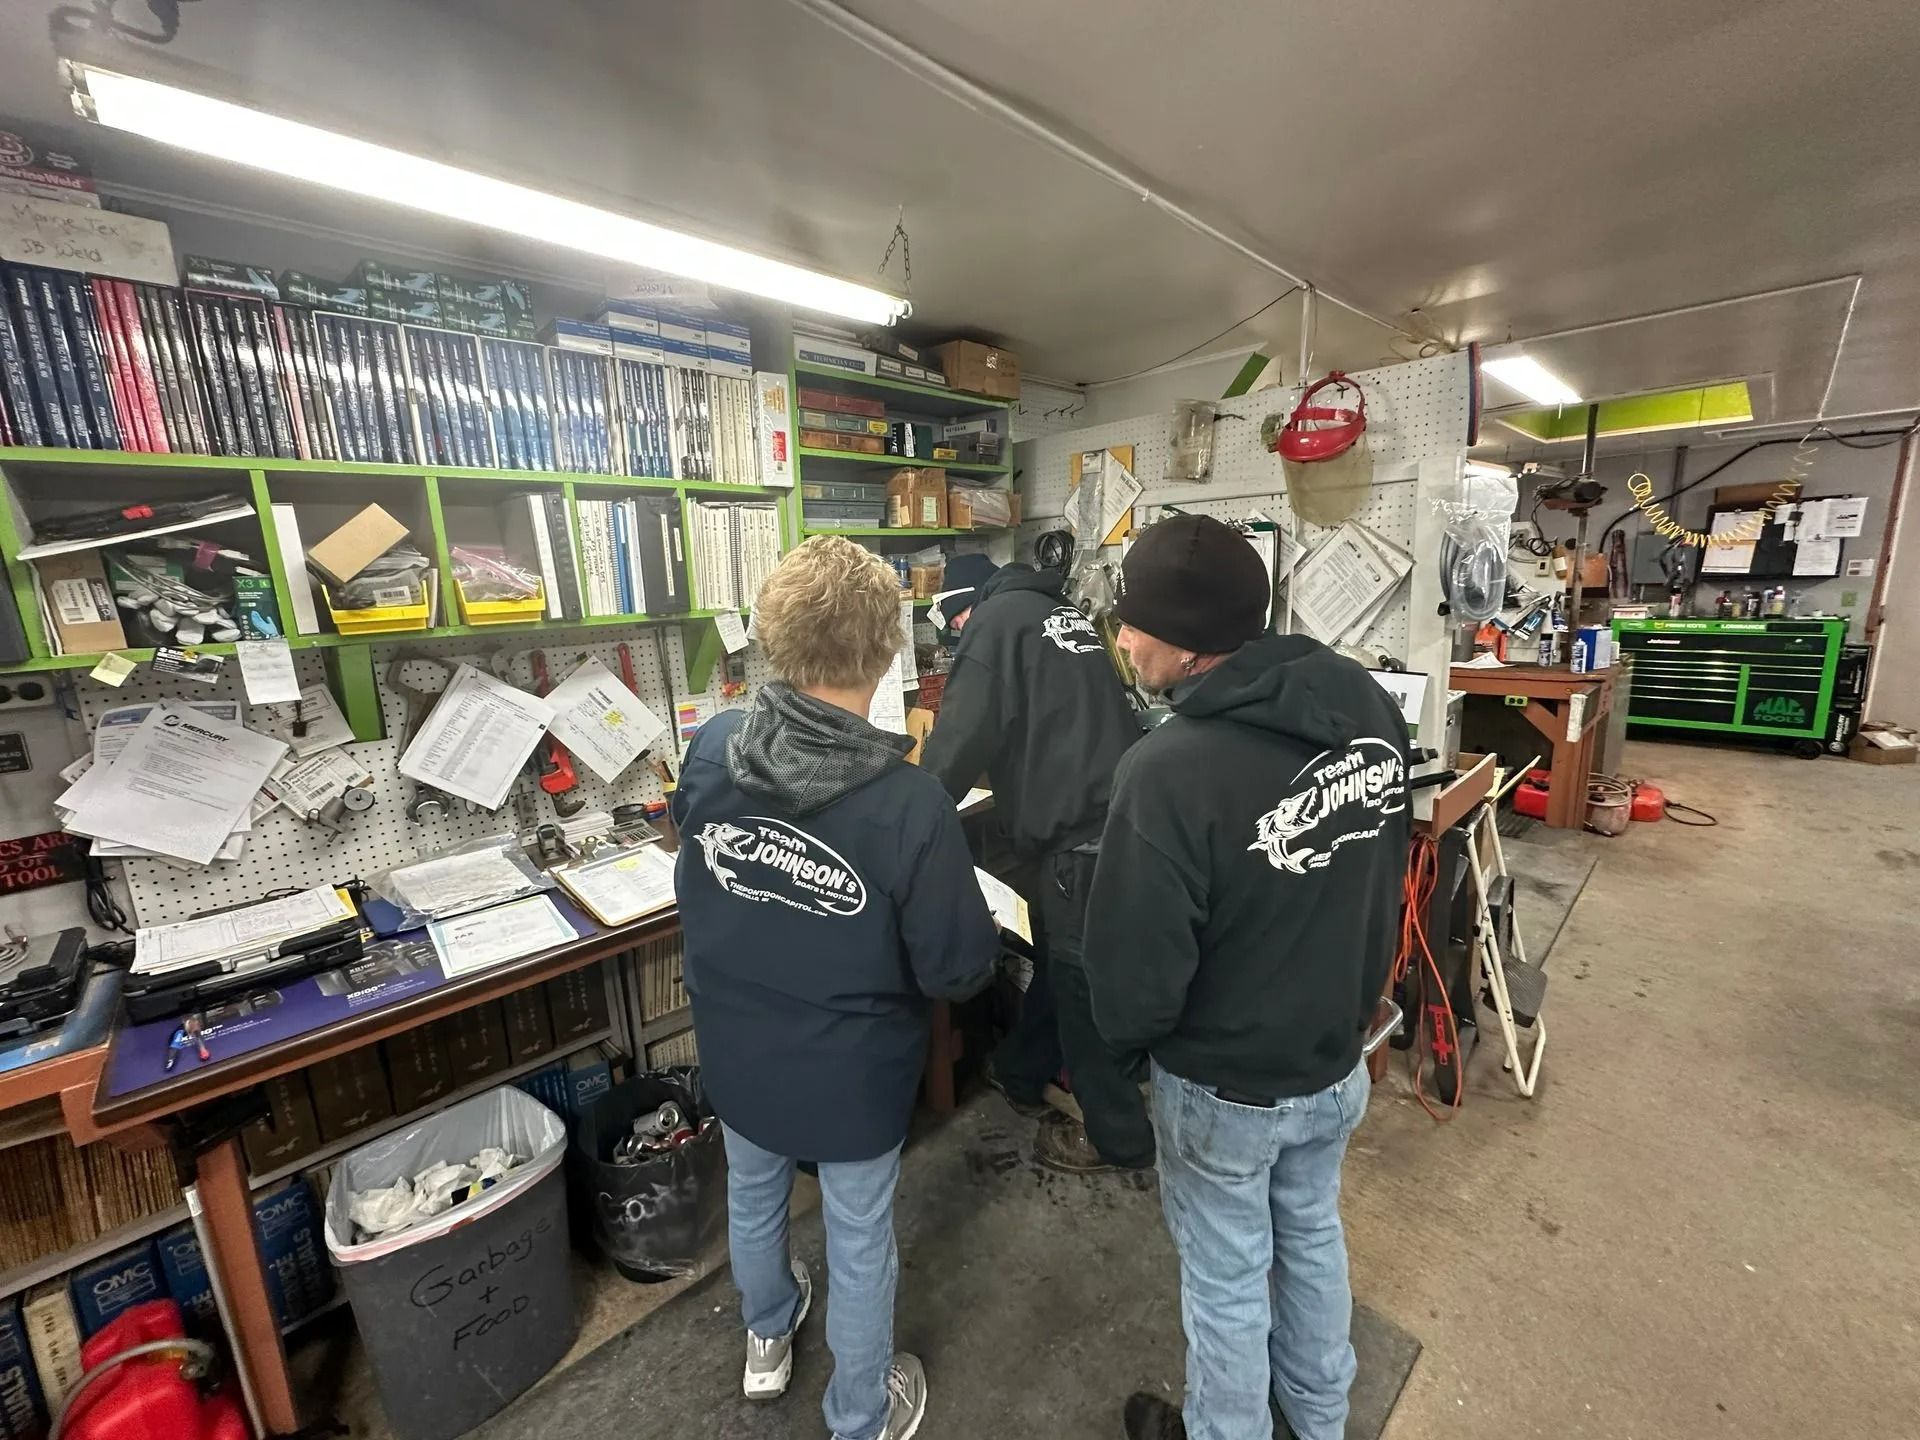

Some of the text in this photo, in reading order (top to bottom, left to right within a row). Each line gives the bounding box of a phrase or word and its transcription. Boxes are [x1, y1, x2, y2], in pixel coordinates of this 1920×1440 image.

[236, 579, 255, 589] X3
[1753, 696, 1806, 716] MAC
[1753, 713, 1805, 724] TOOLS
[180, 723, 230, 743] MERCURY
[826, 890, 860, 905] MOTORS
[576, 1073, 608, 1091] OMC
[259, 1191, 304, 1221] OMC
[410, 1217, 552, 1308] Garbage
[93, 1261, 151, 1295] OMC
